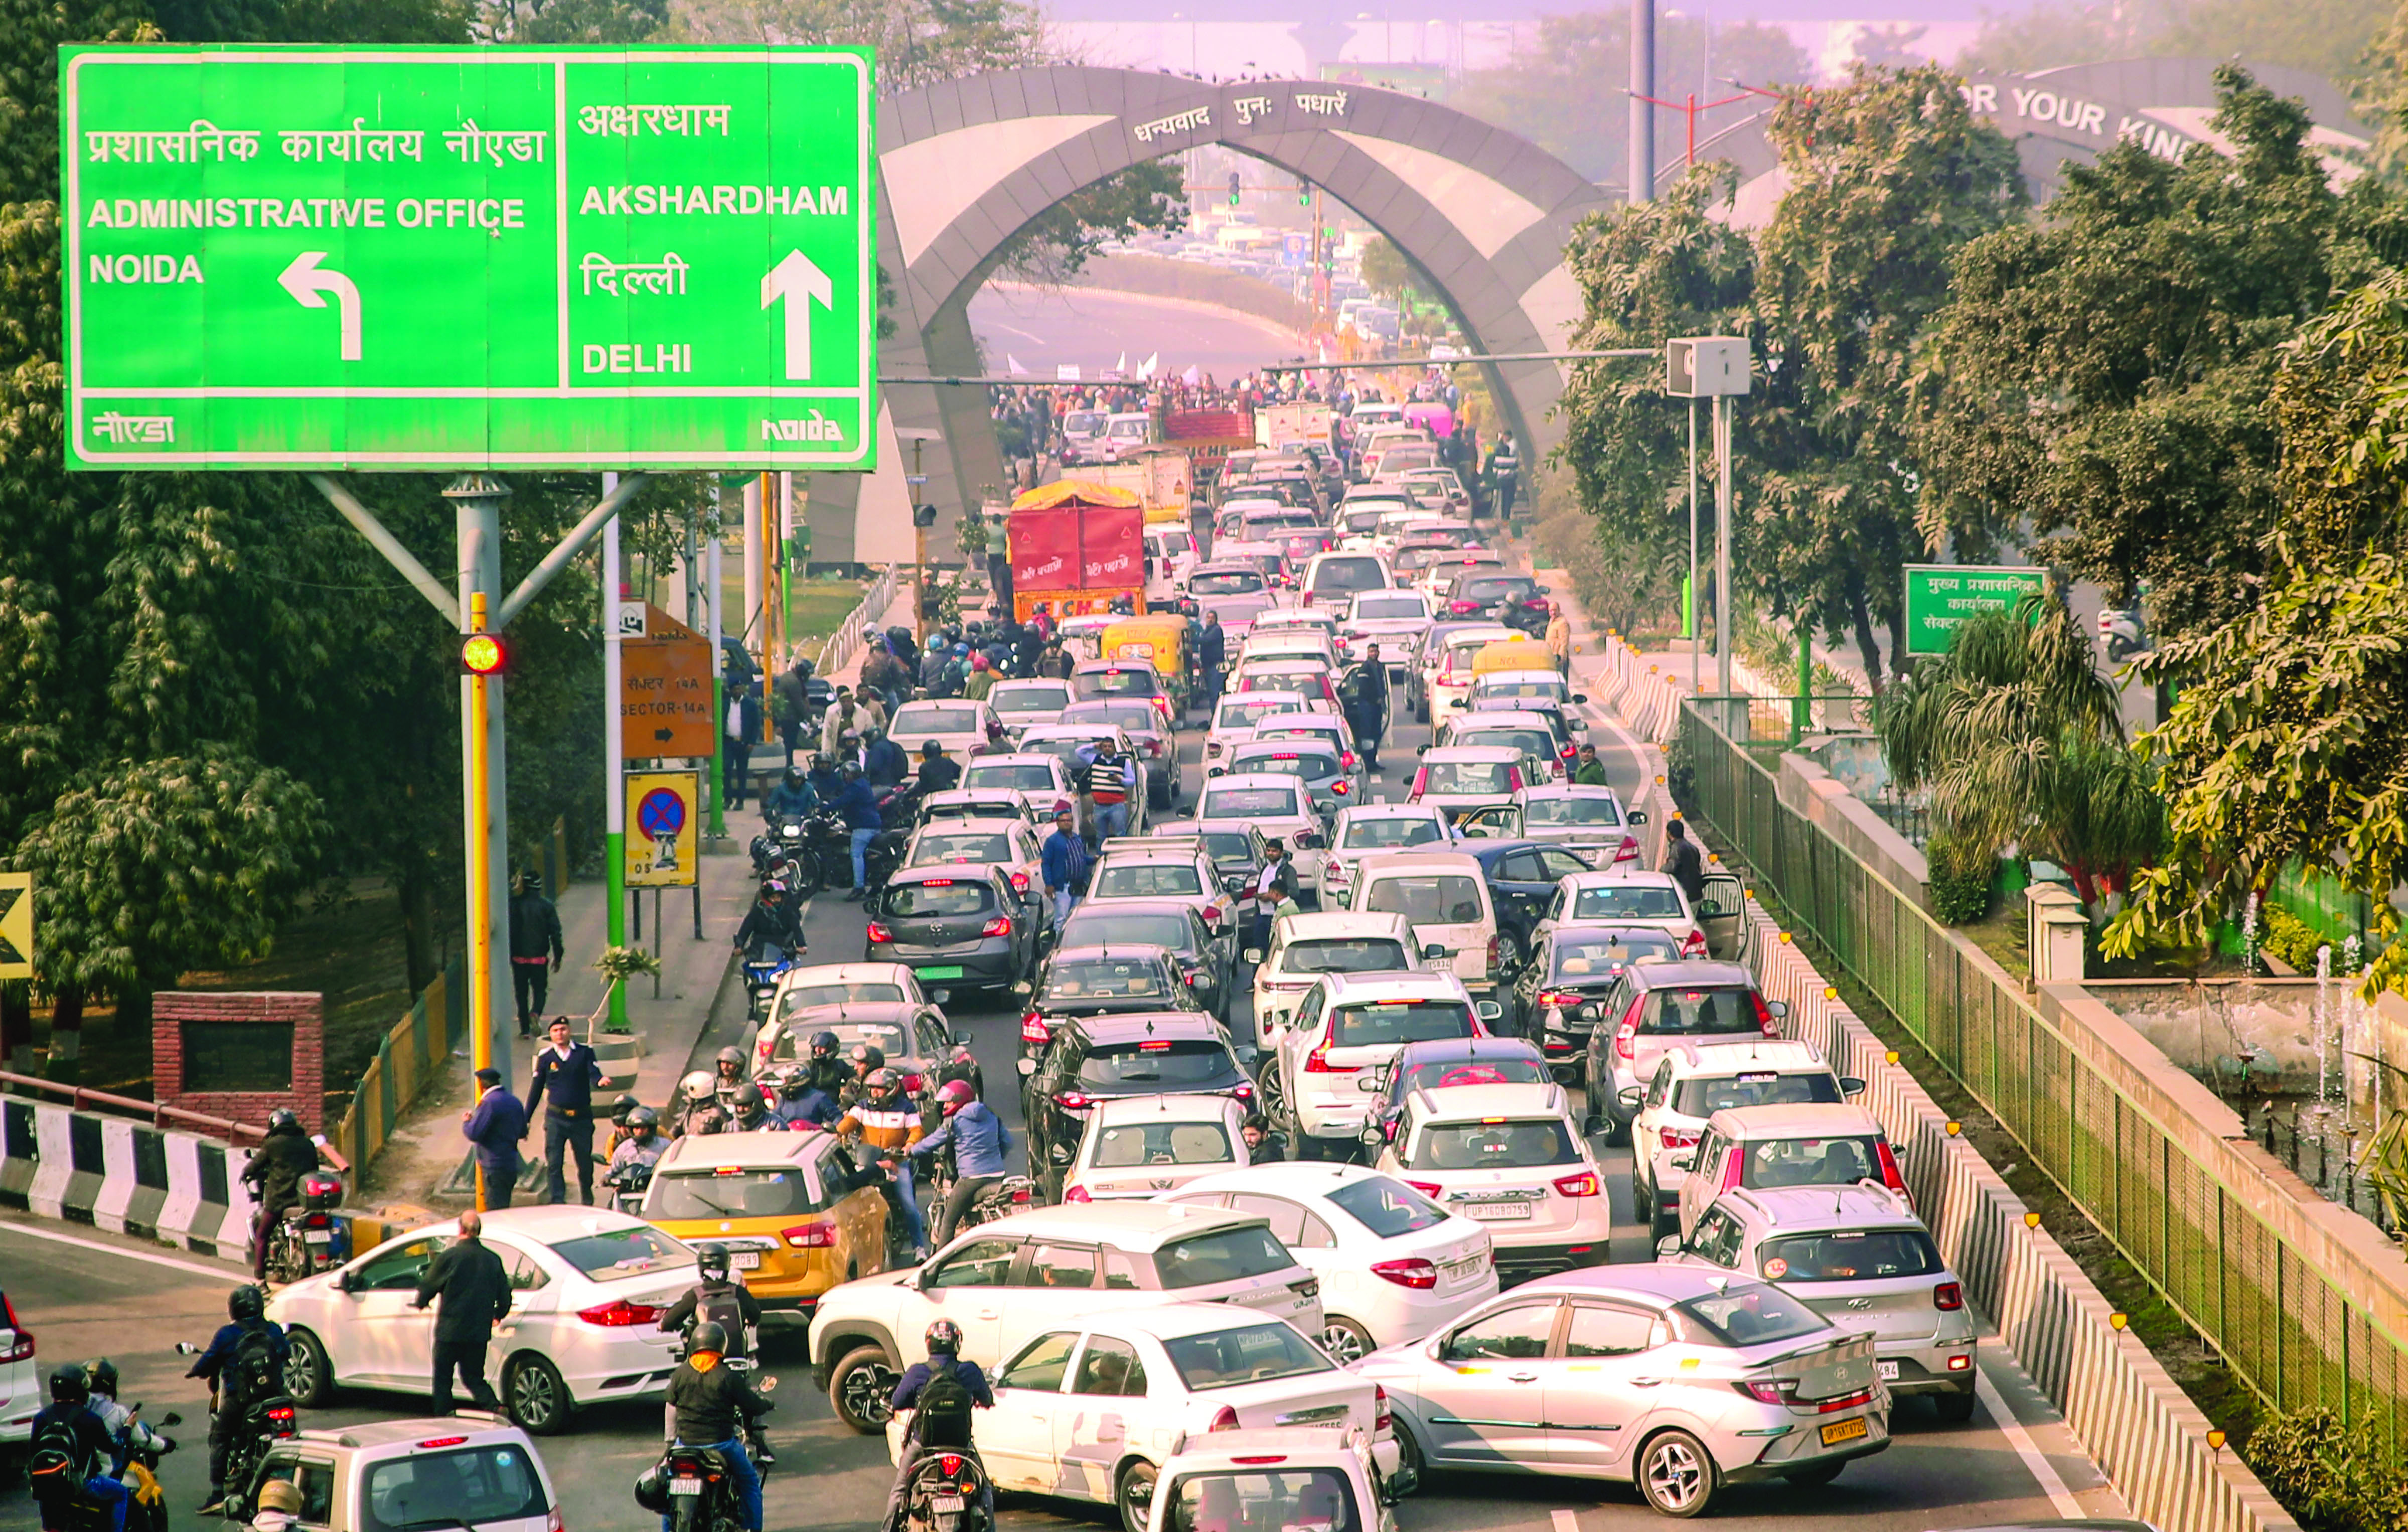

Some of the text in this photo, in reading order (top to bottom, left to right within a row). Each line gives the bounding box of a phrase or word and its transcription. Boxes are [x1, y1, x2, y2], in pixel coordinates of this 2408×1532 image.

[578, 104, 731, 137] अक्षरधाम
[1134, 90, 1348, 143] धन्यवाद पुनः पधारें
[2011, 87, 2106, 135] YOUR
[86, 119, 546, 167] प्रशासनिक कार्यालय नौएडा
[87, 198, 524, 229] ADMINISTRATIVE OFFICE
[580, 185, 848, 216] AKSHARDHAM
[90, 254, 204, 284] NOIDA
[579, 252, 689, 297] दिल्ली
[583, 343, 692, 373] DELHI
[91, 411, 175, 444] नौएडा
[761, 408, 843, 442] noida
[1927, 576, 2037, 594] मुख्य प्रशासनिक
[675, 679, 699, 689] 14A
